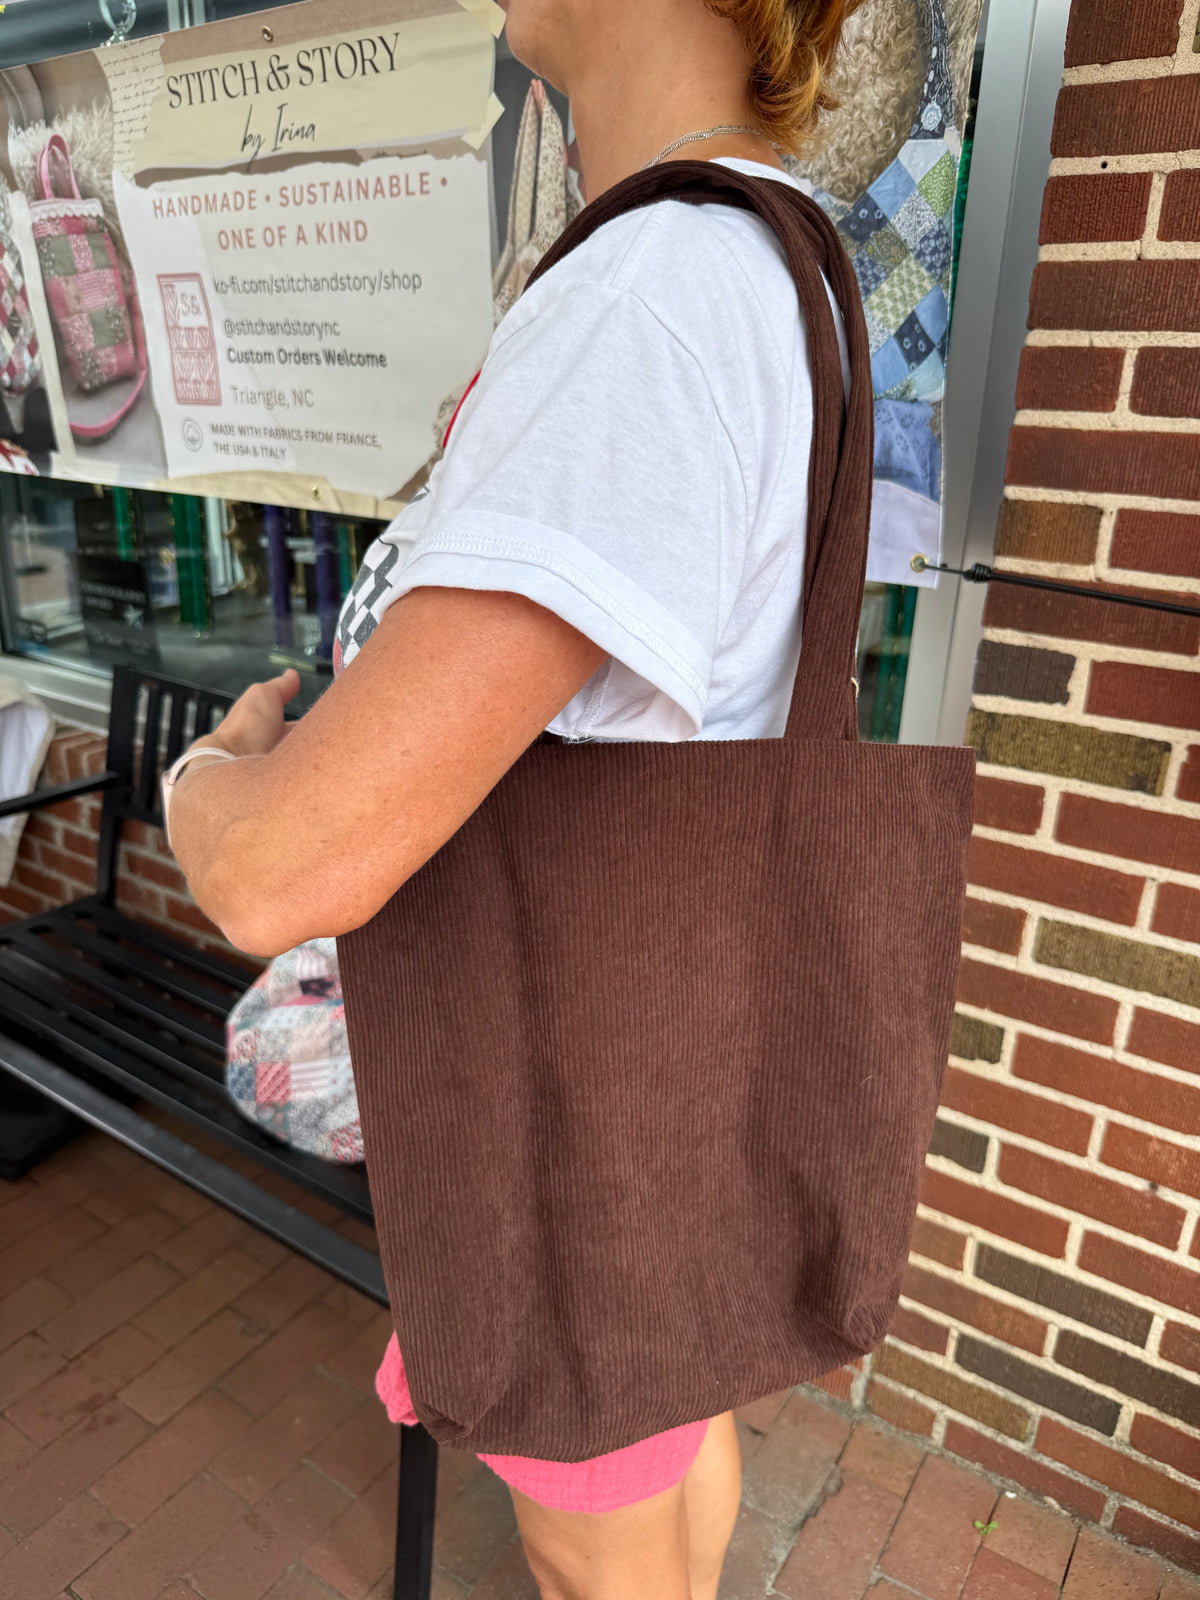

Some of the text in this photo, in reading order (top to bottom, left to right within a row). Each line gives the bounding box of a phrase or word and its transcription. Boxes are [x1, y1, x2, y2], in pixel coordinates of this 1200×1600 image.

[167, 32, 400, 109] STITCH & STORY
[241, 102, 316, 172] by Irina
[153, 171, 431, 219] HANDMADE SUSTAINABLE
[218, 220, 368, 250] ONE OF A KIND
[213, 270, 423, 296] ko-fi.com/stitchandstory/shop
[224, 317, 341, 341] @stitchandstorync
[227, 347, 387, 368] Custom Orders Welcome
[230, 385, 315, 411] Triangle, NC
[211, 423, 382, 450] MADE WITH FABRICS FROM FRANCE,
[213, 442, 230, 455] THE
[233, 443, 250, 457] USA
[260, 446, 286, 460] ITALY
